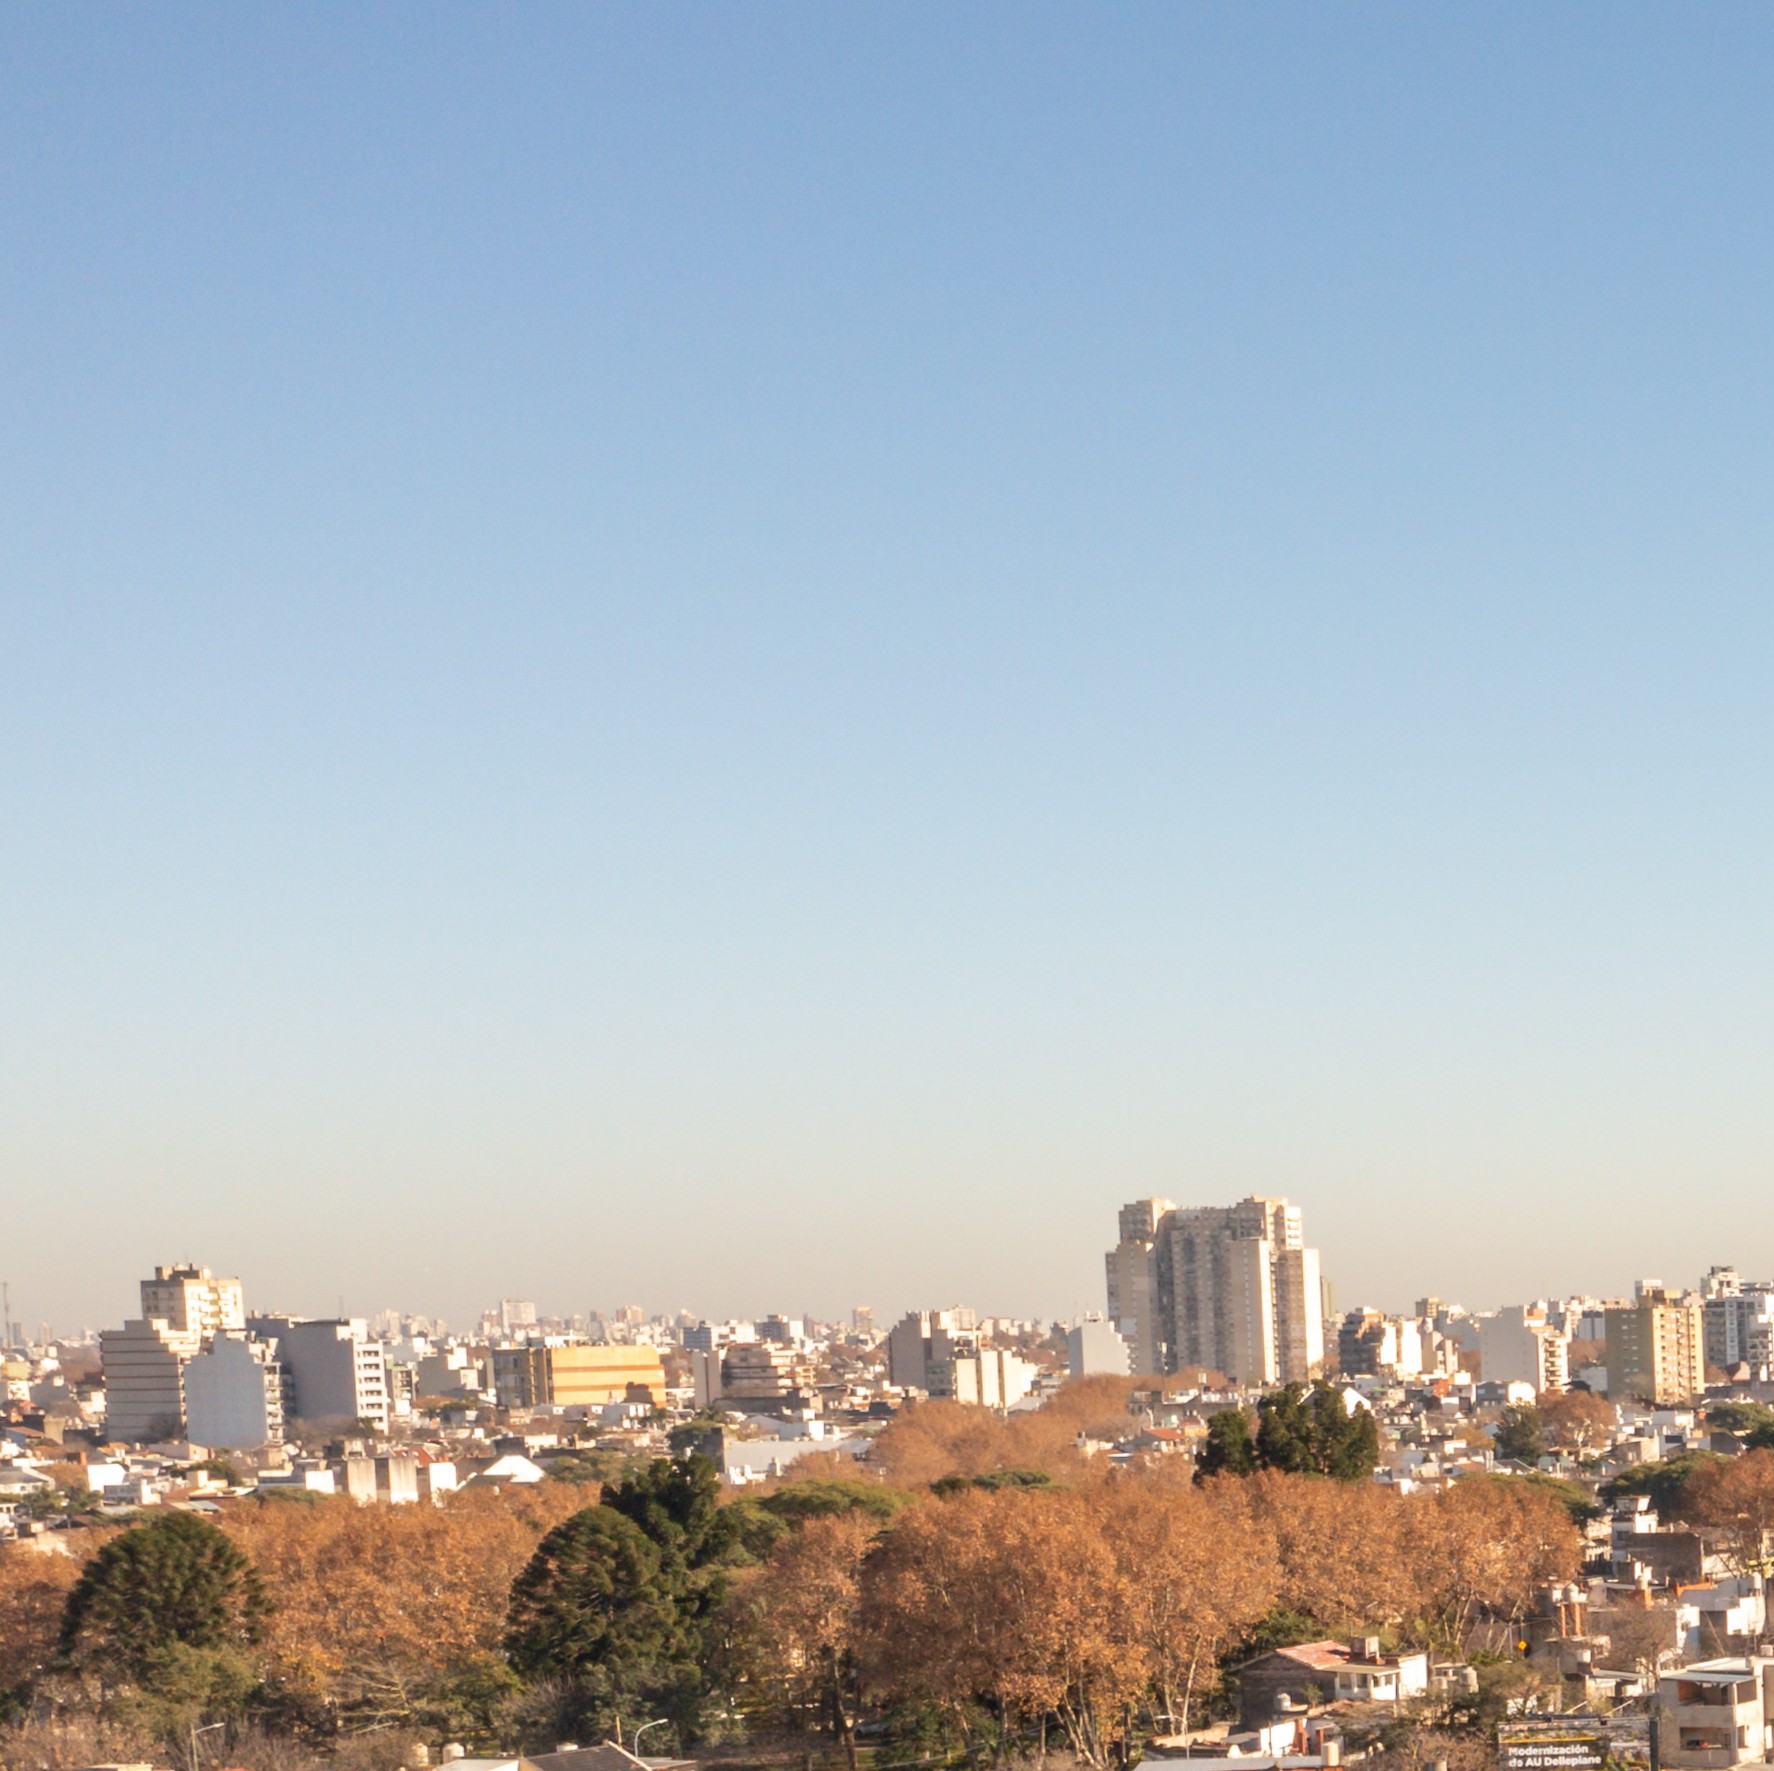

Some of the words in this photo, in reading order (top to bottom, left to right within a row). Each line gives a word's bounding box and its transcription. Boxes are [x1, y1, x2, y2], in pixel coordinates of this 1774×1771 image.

[1508, 1744, 1589, 1757] Modernización
[1508, 1758, 1523, 1768] de
[1525, 1758, 1542, 1767] AU
[1544, 1755, 1602, 1767] Dellepiane
